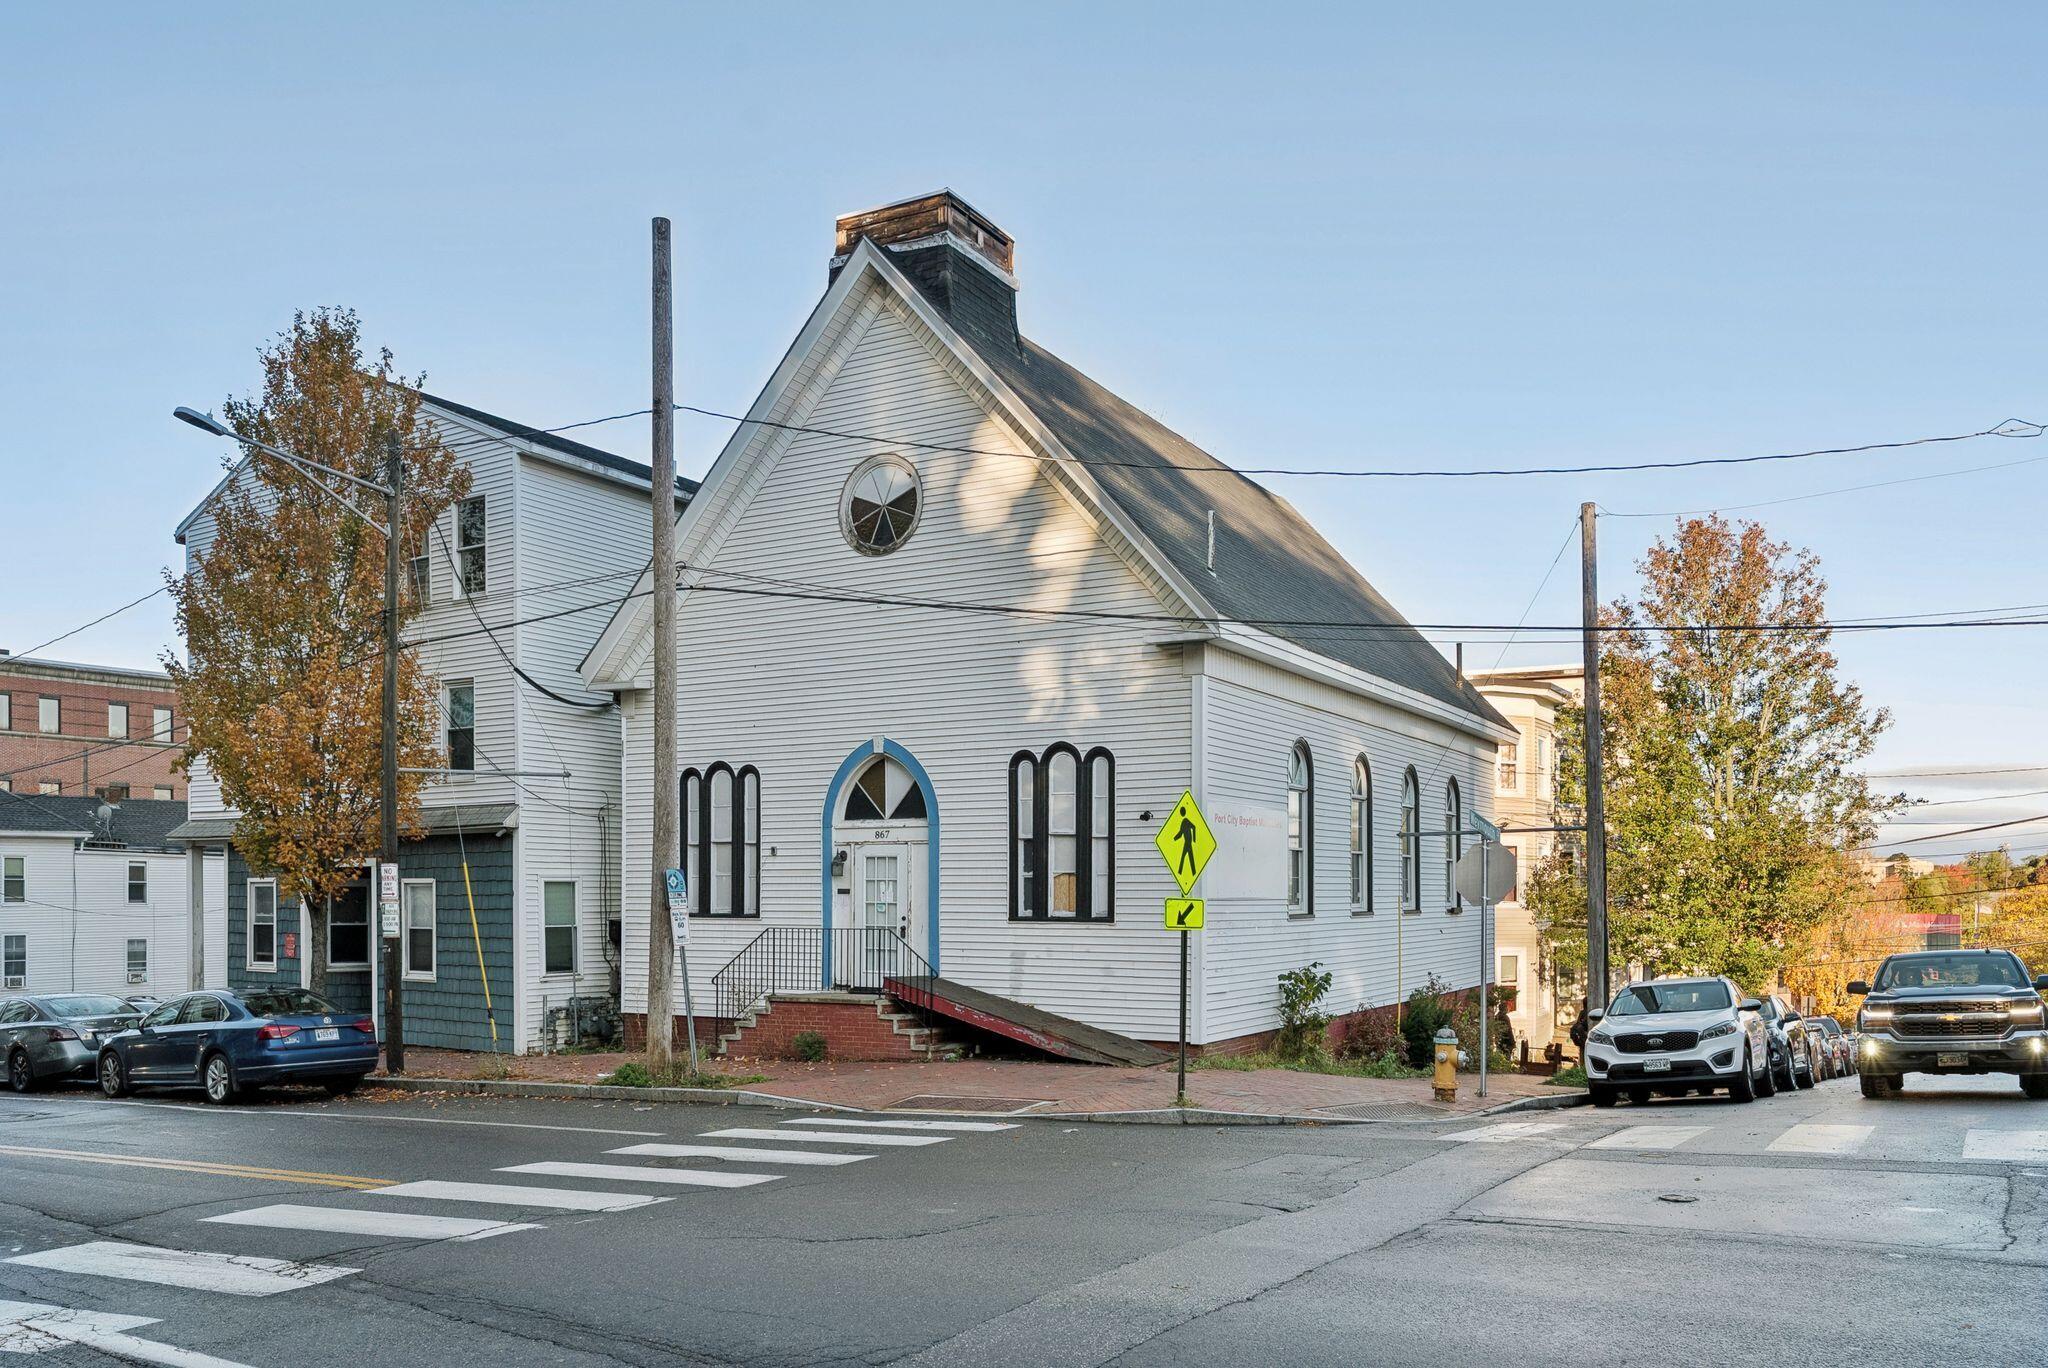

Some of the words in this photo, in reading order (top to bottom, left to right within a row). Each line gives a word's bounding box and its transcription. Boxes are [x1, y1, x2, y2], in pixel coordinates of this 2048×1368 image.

[1214, 813, 1226, 824] Port
[1227, 814, 1239, 827] City
[1239, 815, 1258, 828] Baptist
[875, 830, 890, 839] 867
